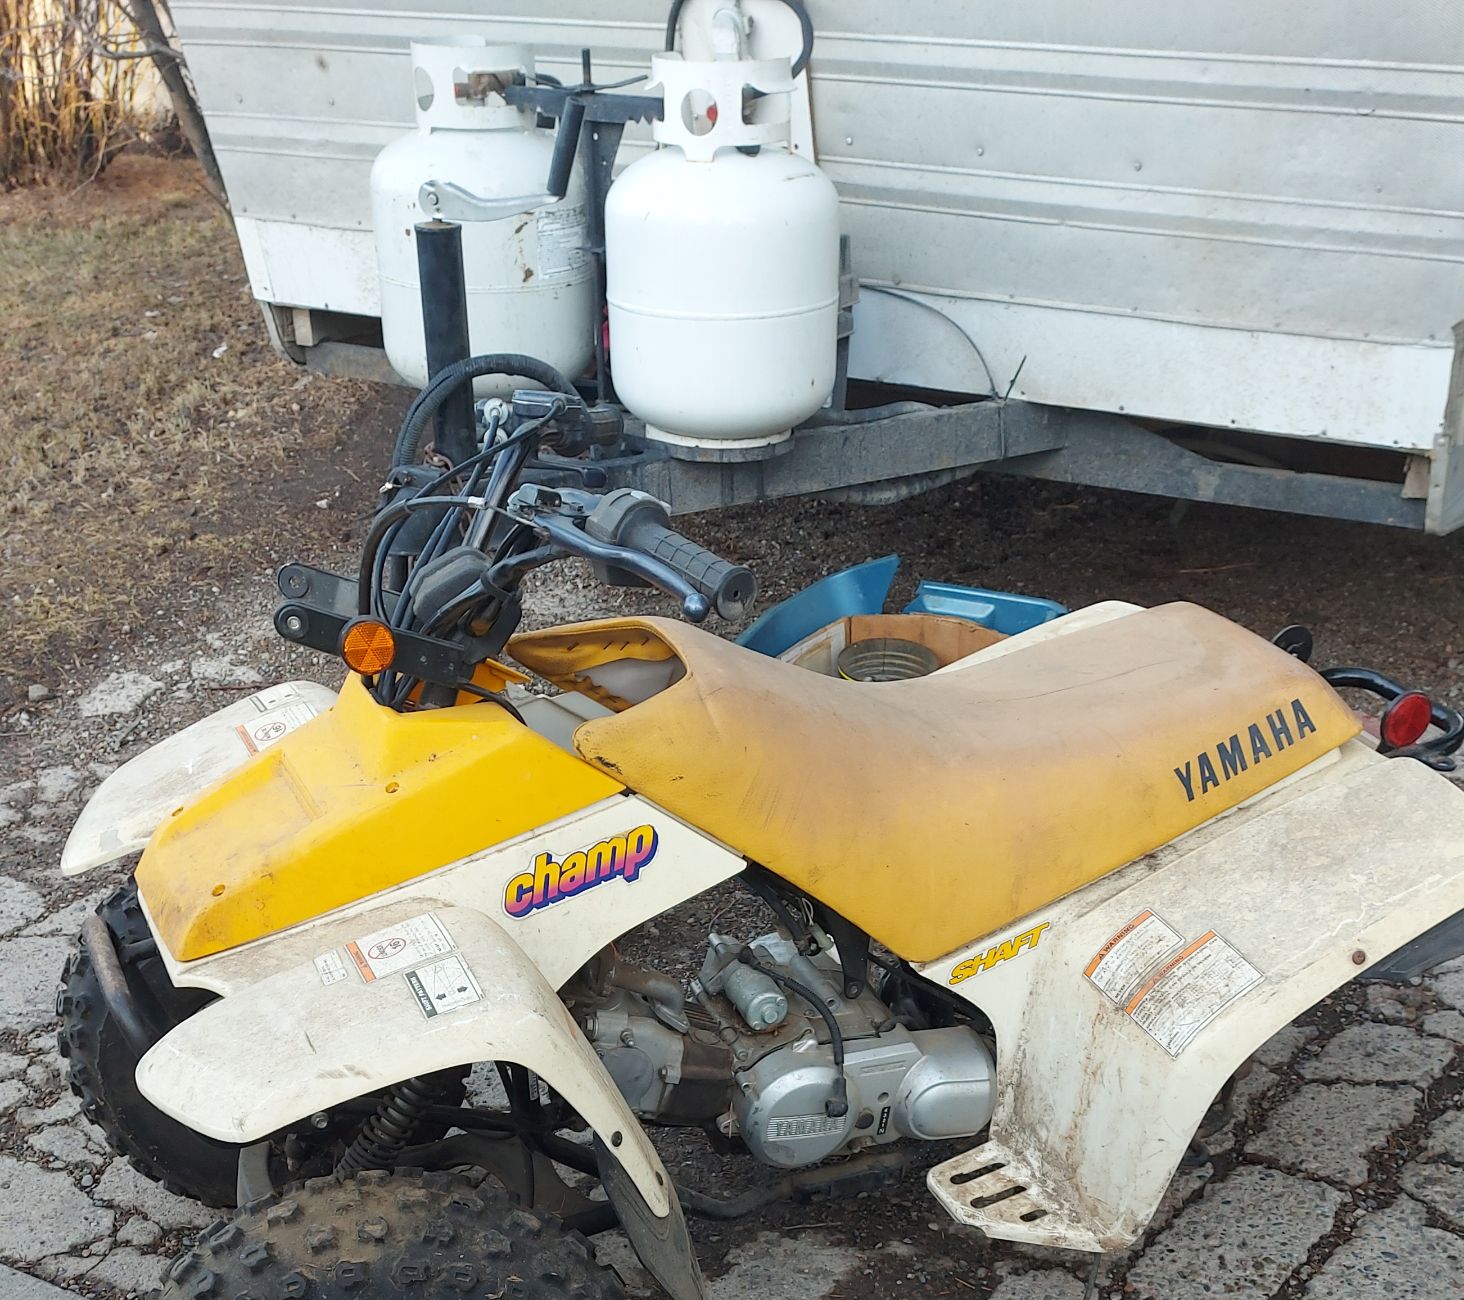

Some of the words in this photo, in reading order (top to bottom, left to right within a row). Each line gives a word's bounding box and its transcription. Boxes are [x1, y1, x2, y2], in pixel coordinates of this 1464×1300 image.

[1174, 699, 1316, 801] YAMAHA
[505, 824, 658, 917] champ
[949, 922, 1050, 985] SHAFT
[1104, 923, 1135, 953] WARNING
